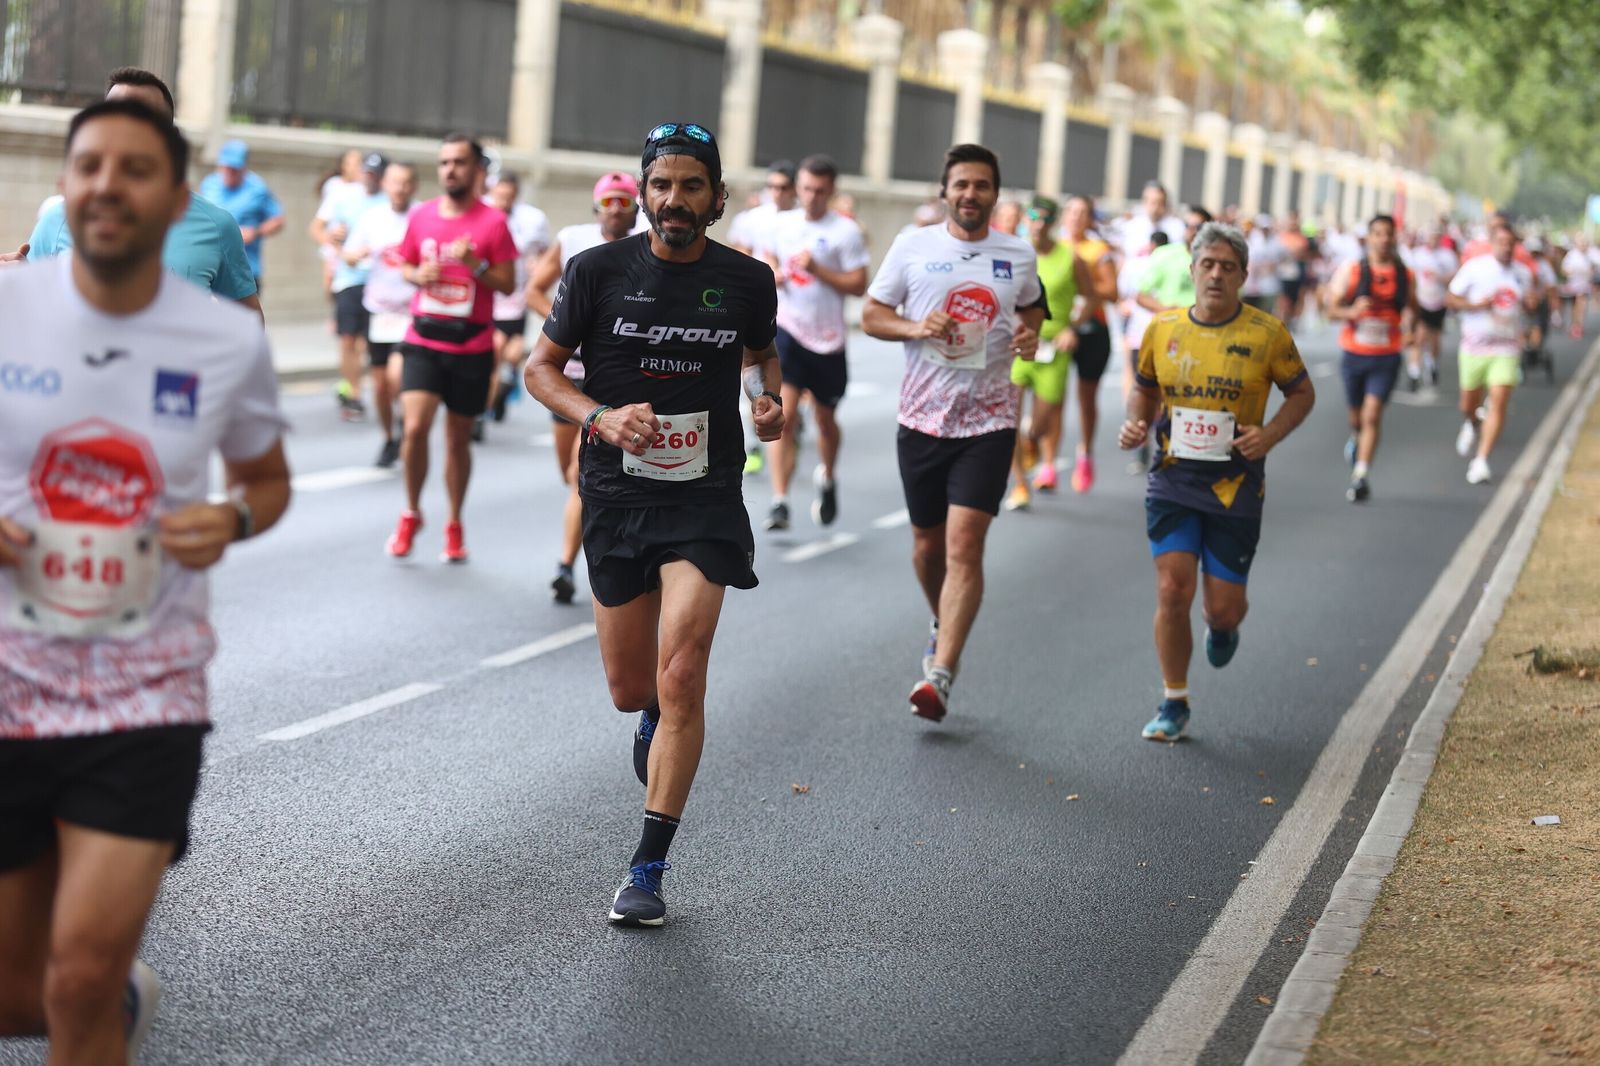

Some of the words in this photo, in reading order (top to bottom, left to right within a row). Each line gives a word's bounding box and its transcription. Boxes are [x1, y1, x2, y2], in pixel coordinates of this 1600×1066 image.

[640, 358, 702, 373] PRIMOR
[1207, 375, 1243, 389] TRAIL
[1184, 385, 1241, 401] SANTO
[1184, 421, 1218, 436] 739
[43, 555, 125, 584] 648
